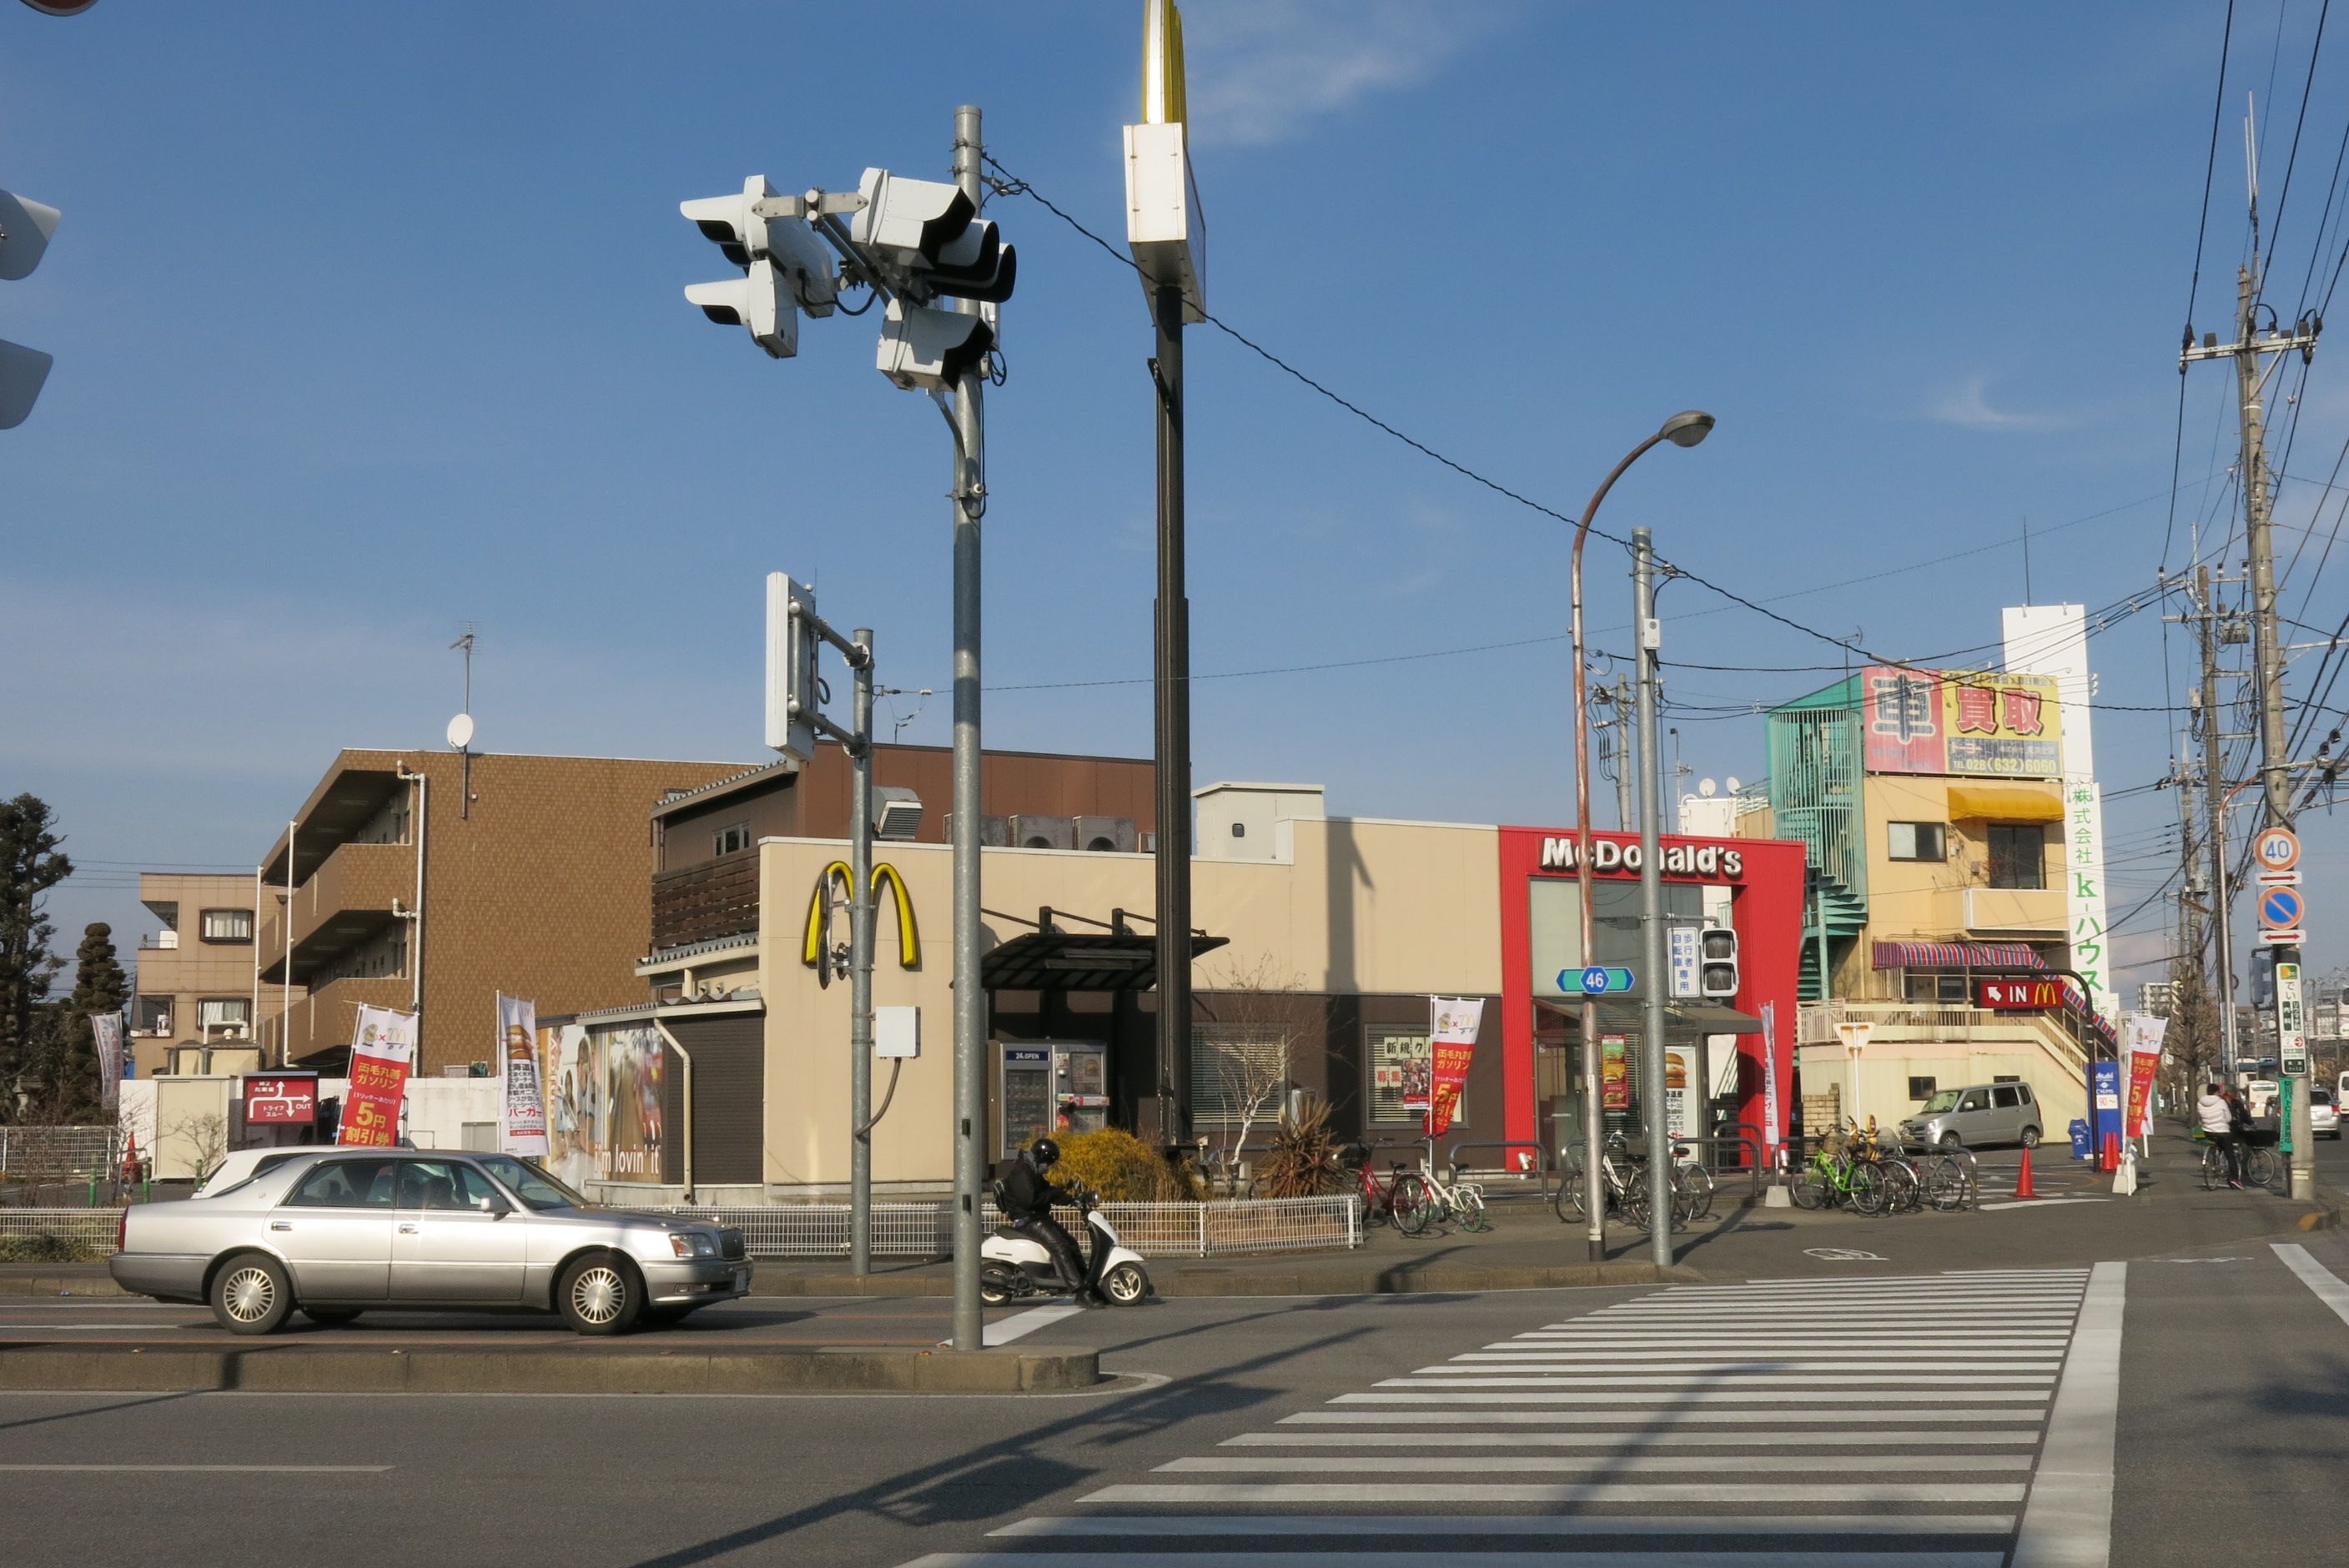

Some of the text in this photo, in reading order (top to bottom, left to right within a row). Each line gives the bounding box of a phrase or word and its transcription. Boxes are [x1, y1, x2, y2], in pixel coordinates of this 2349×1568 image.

[1872, 673, 1935, 744] 車
[1955, 686, 2044, 736] 買取
[1542, 837, 1742, 876] MDoald's
[2266, 840, 2289, 859] 40
[1586, 972, 1604, 988] 46
[2009, 985, 2028, 1003] IN
[357, 1074, 398, 1090] ガソリン
[356, 1101, 386, 1128] 5円
[594, 1143, 661, 1175] i'm lovin' it
